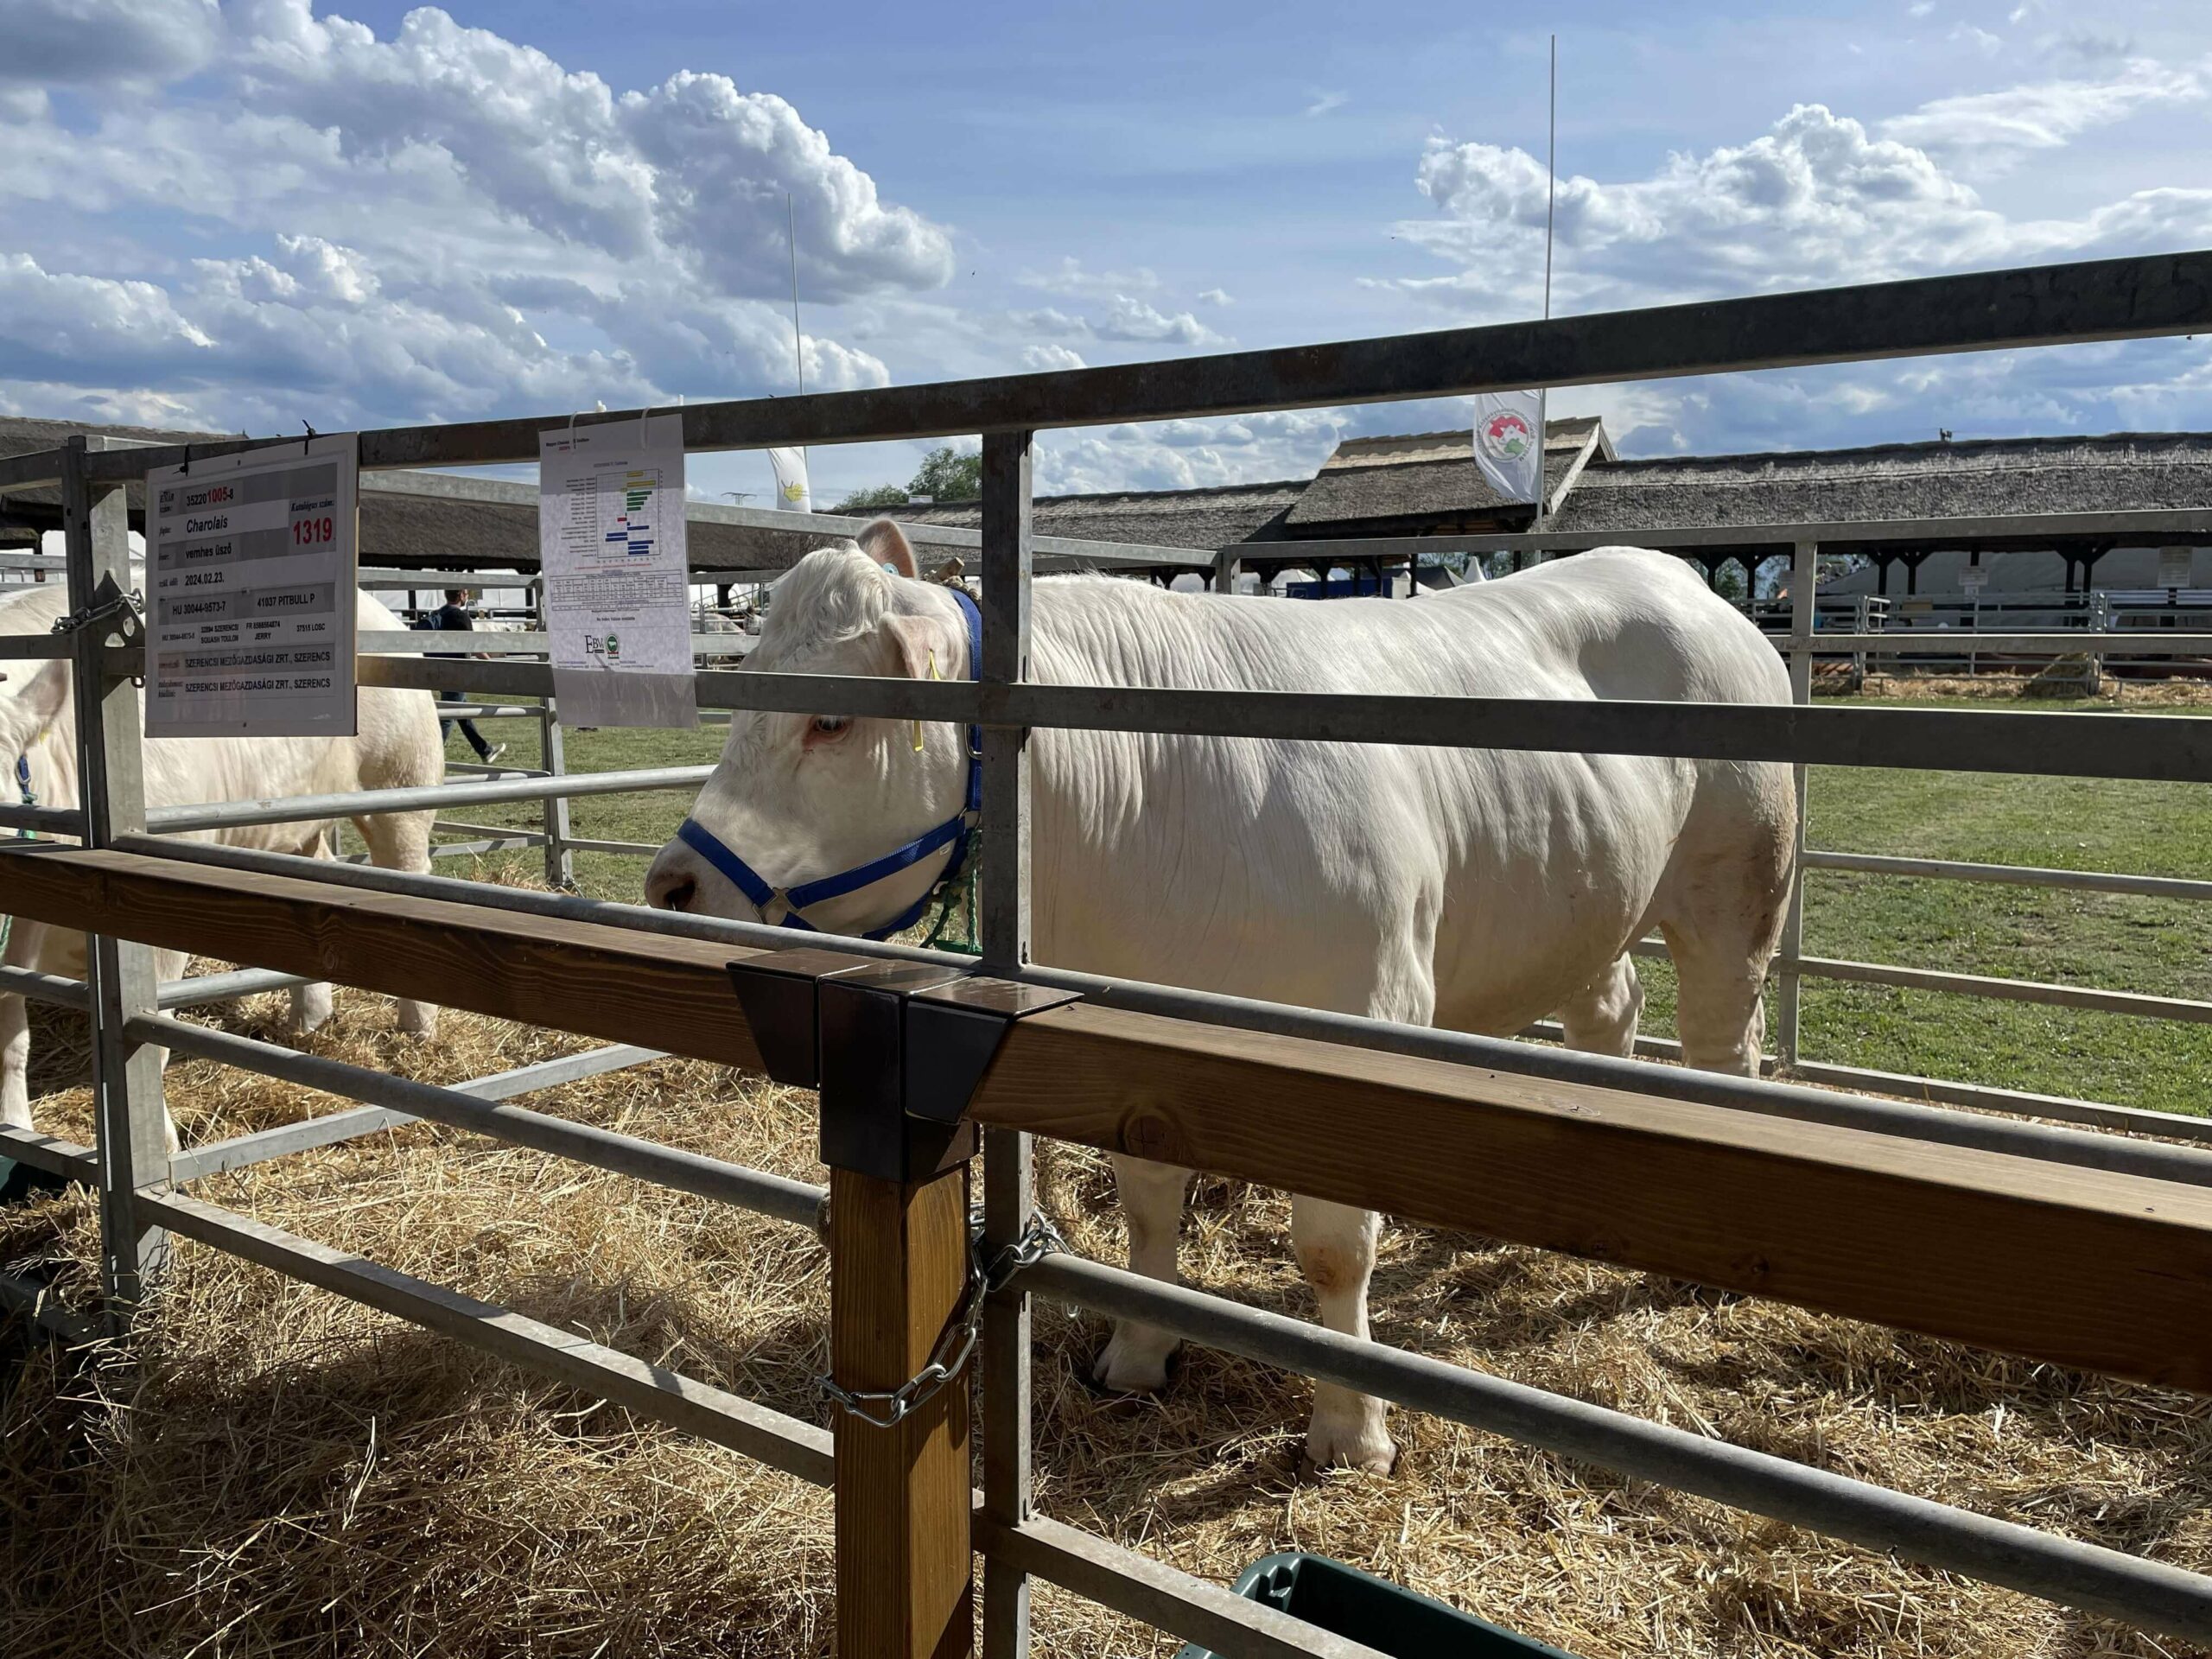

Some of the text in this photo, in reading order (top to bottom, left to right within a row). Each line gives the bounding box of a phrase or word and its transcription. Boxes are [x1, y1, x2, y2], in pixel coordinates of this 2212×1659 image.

[187, 515, 228, 533] Charolais
[293, 517, 333, 545] 1319
[186, 546, 213, 559] vemhes
[185, 571, 225, 586] 2024.02.23.
[257, 593, 315, 607] 41037 PITBULL P
[172, 601, 226, 615] HU 30044-9573-7
[311, 623, 326, 632] LOSC
[185, 658, 219, 668] SZERENCSI
[294, 652, 330, 663] SZERENCS
[185, 683, 219, 692] SZERENCSI
[294, 677, 331, 689] SZERENCS
